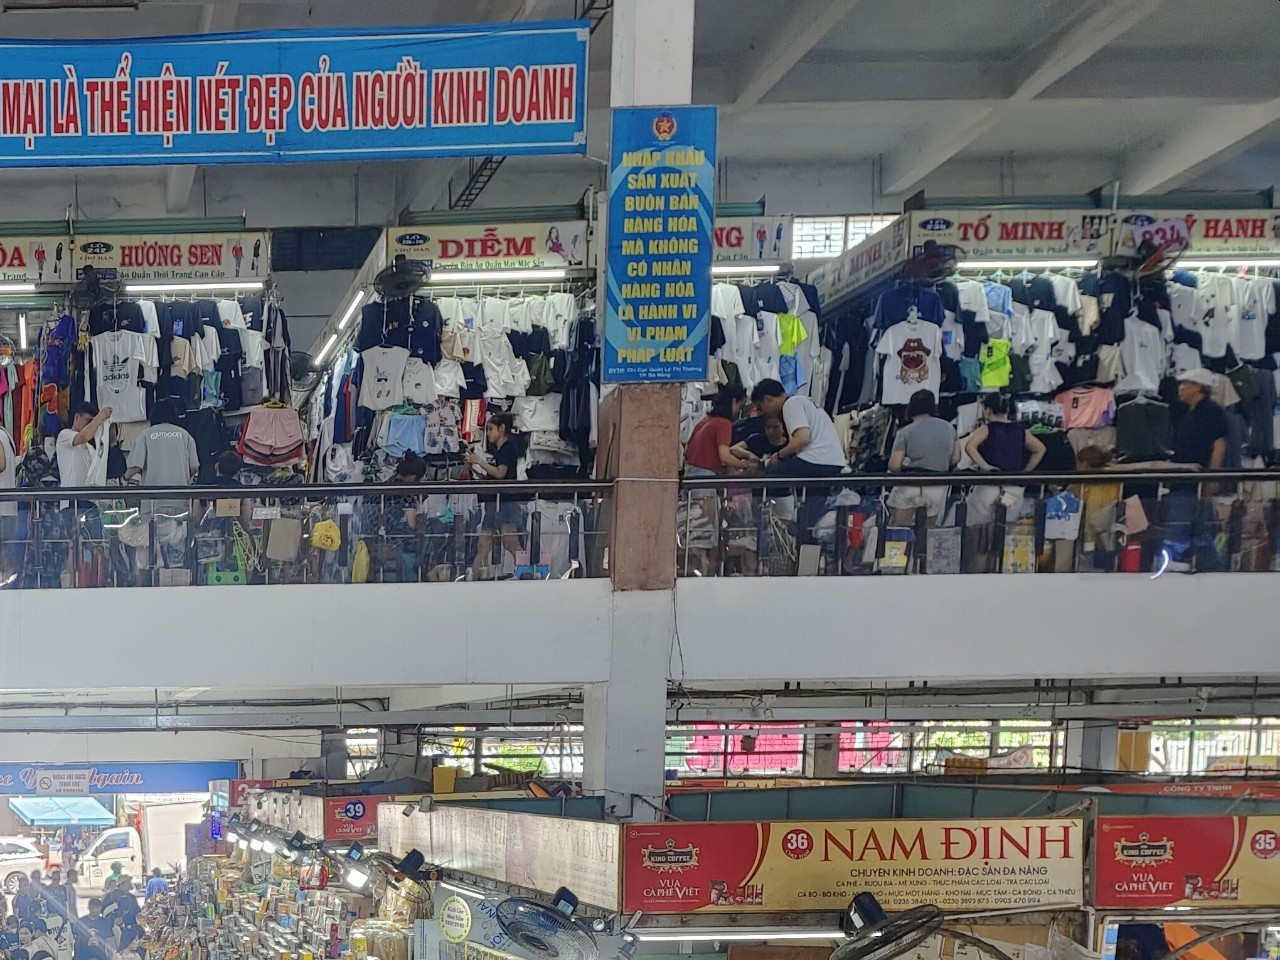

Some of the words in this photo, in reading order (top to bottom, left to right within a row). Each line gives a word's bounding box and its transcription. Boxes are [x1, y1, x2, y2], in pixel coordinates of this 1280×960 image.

[0, 77, 46, 151] MẠI
[50, 64, 81, 136] LÀ
[83, 52, 133, 136] THỂ
[135, 62, 193, 148] HIỆN
[196, 61, 243, 134] NÉT
[245, 74, 295, 147] ĐẸP
[297, 54, 351, 132] CỦA
[352, 56, 428, 130] NGƯỜI
[430, 67, 490, 127] KINH
[493, 64, 578, 125] DOANH
[622, 149, 661, 167] NHẬP
[627, 171, 656, 189] SẢN
[660, 168, 698, 188] XUẤT
[625, 193, 665, 211] BUÔN
[669, 192, 699, 210] BÁN
[624, 216, 663, 233] HÀNG
[668, 215, 698, 232] HÓA
[958, 214, 992, 241] TỐ
[998, 221, 1067, 241] MINH
[1203, 218, 1267, 243] HẠNH
[437, 227, 536, 259] DIỄM
[622, 237, 644, 255] MÀ
[648, 236, 699, 254] KHÔNG
[120, 241, 183, 267] HƯƠNG
[188, 244, 223, 266] SEN
[171, 270, 193, 279] Trang
[627, 259, 648, 277] CÓ
[622, 281, 661, 299] HÀNG
[665, 280, 695, 297] HÓA
[618, 303, 634, 320] LÀ
[639, 303, 677, 320] HÀNH
[682, 304, 697, 318] VI
[627, 327, 641, 343] VI
[646, 326, 687, 342] PHẠM
[618, 347, 655, 363] PHÁP
[659, 346, 694, 364] LUẬT
[103, 372, 129, 382] adidas
[346, 803, 364, 817] 39
[787, 834, 807, 850] 36
[821, 827, 931, 862] NAM
[940, 827, 1074, 866] ĐỊNH
[1255, 834, 1276, 850] 35
[850, 867, 890, 878] CHUYÊN
[892, 868, 916, 877] KINH
[918, 868, 956, 877] DOANH:
[958, 867, 979, 878] ĐẶC
[1132, 873, 1155, 881] VUA
[643, 887, 656, 897] CÀ
[657, 886, 673, 896] PHÊ
[672, 887, 699, 899] VIỆT
[659, 879, 681, 888] VUA
[1129, 881, 1147, 891] PHÊ
[1148, 881, 1174, 894] VIỆT
